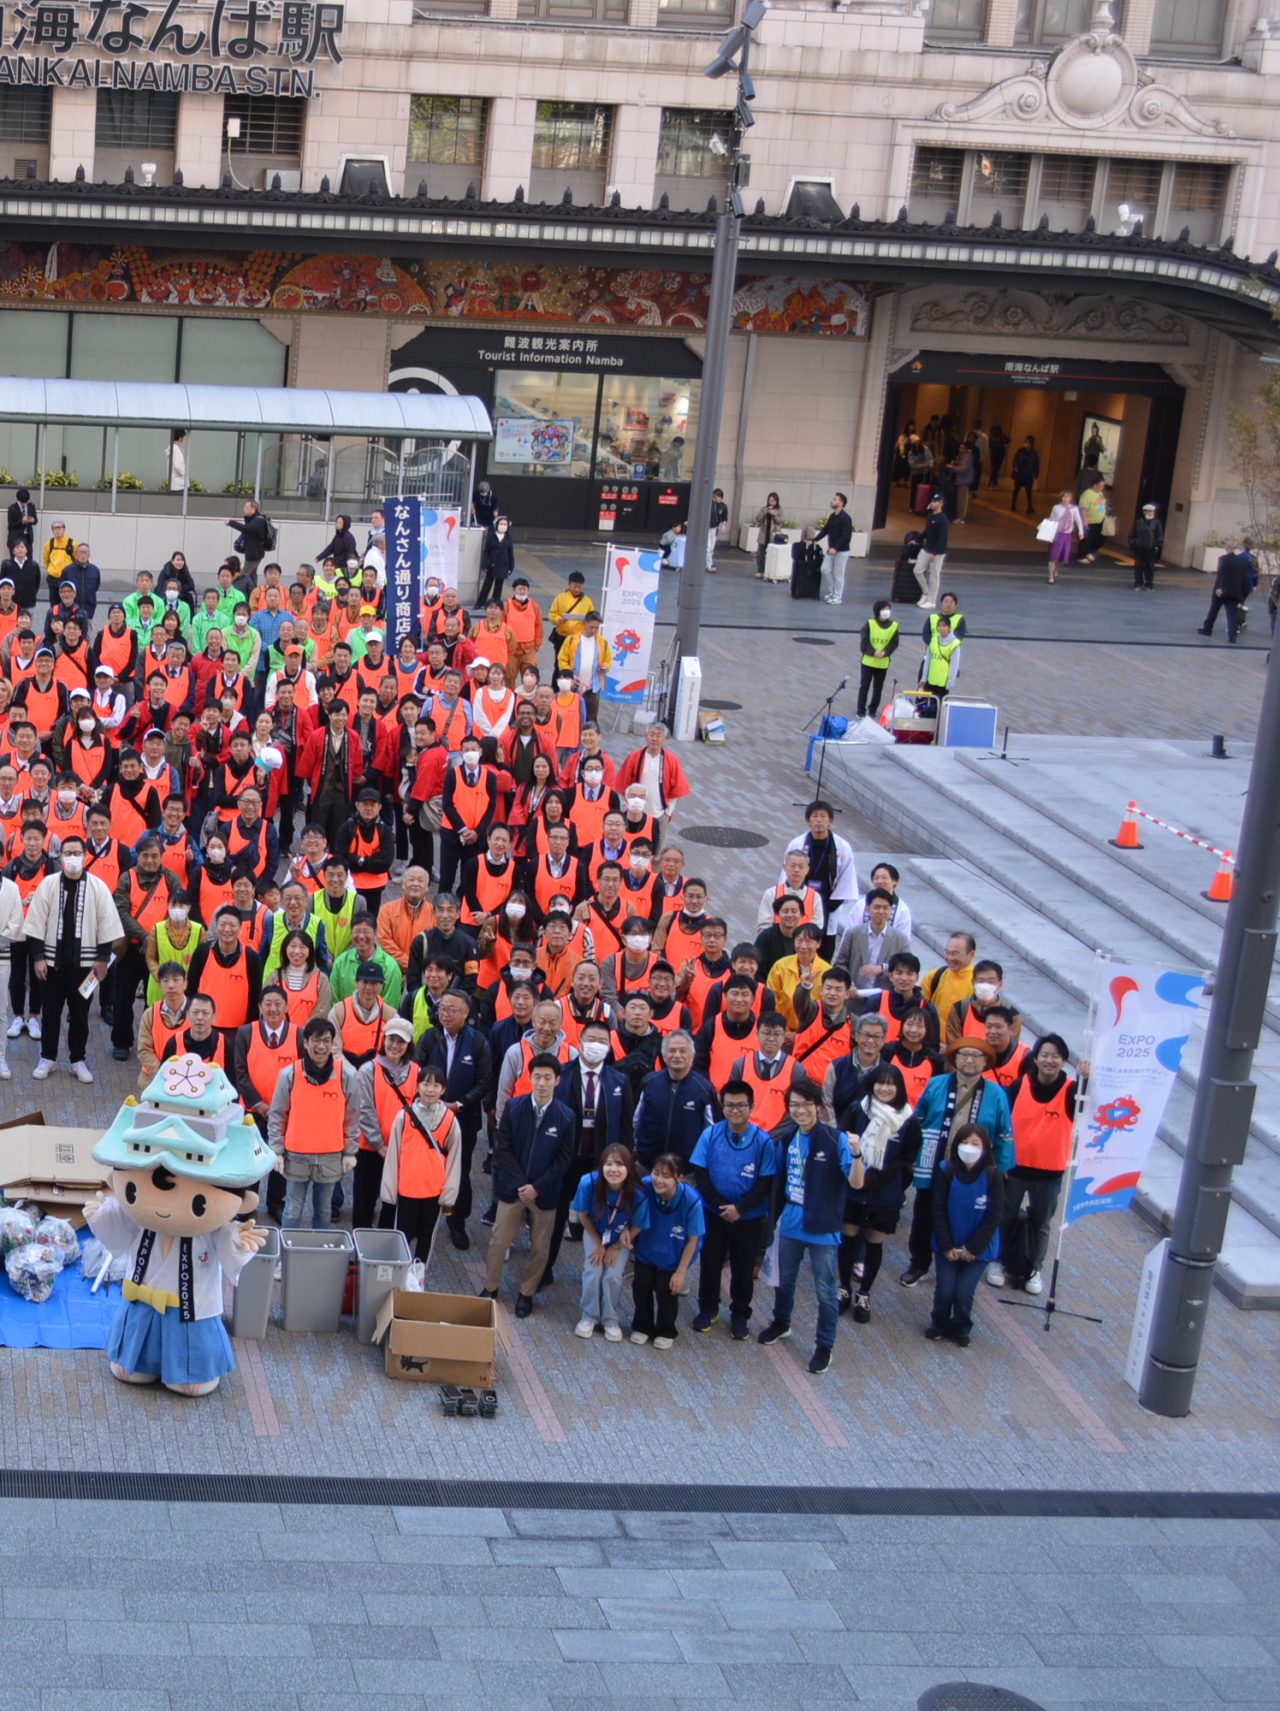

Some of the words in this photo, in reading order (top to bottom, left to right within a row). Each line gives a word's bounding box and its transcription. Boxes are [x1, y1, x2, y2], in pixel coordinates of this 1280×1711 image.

[111, 58, 238, 94] NAMBA
[245, 64, 322, 99] STN.
[504, 335, 599, 353] 難波観光案内所
[478, 349, 516, 362] Tourist
[519, 351, 582, 365] Information
[585, 354, 624, 367] Namba
[621, 598, 642, 606] 2025
[622, 590, 643, 599] EXPO
[1118, 1033, 1156, 1046] EXPO
[1116, 1047, 1151, 1058] 2025
[180, 1243, 191, 1320] EXPO2025
